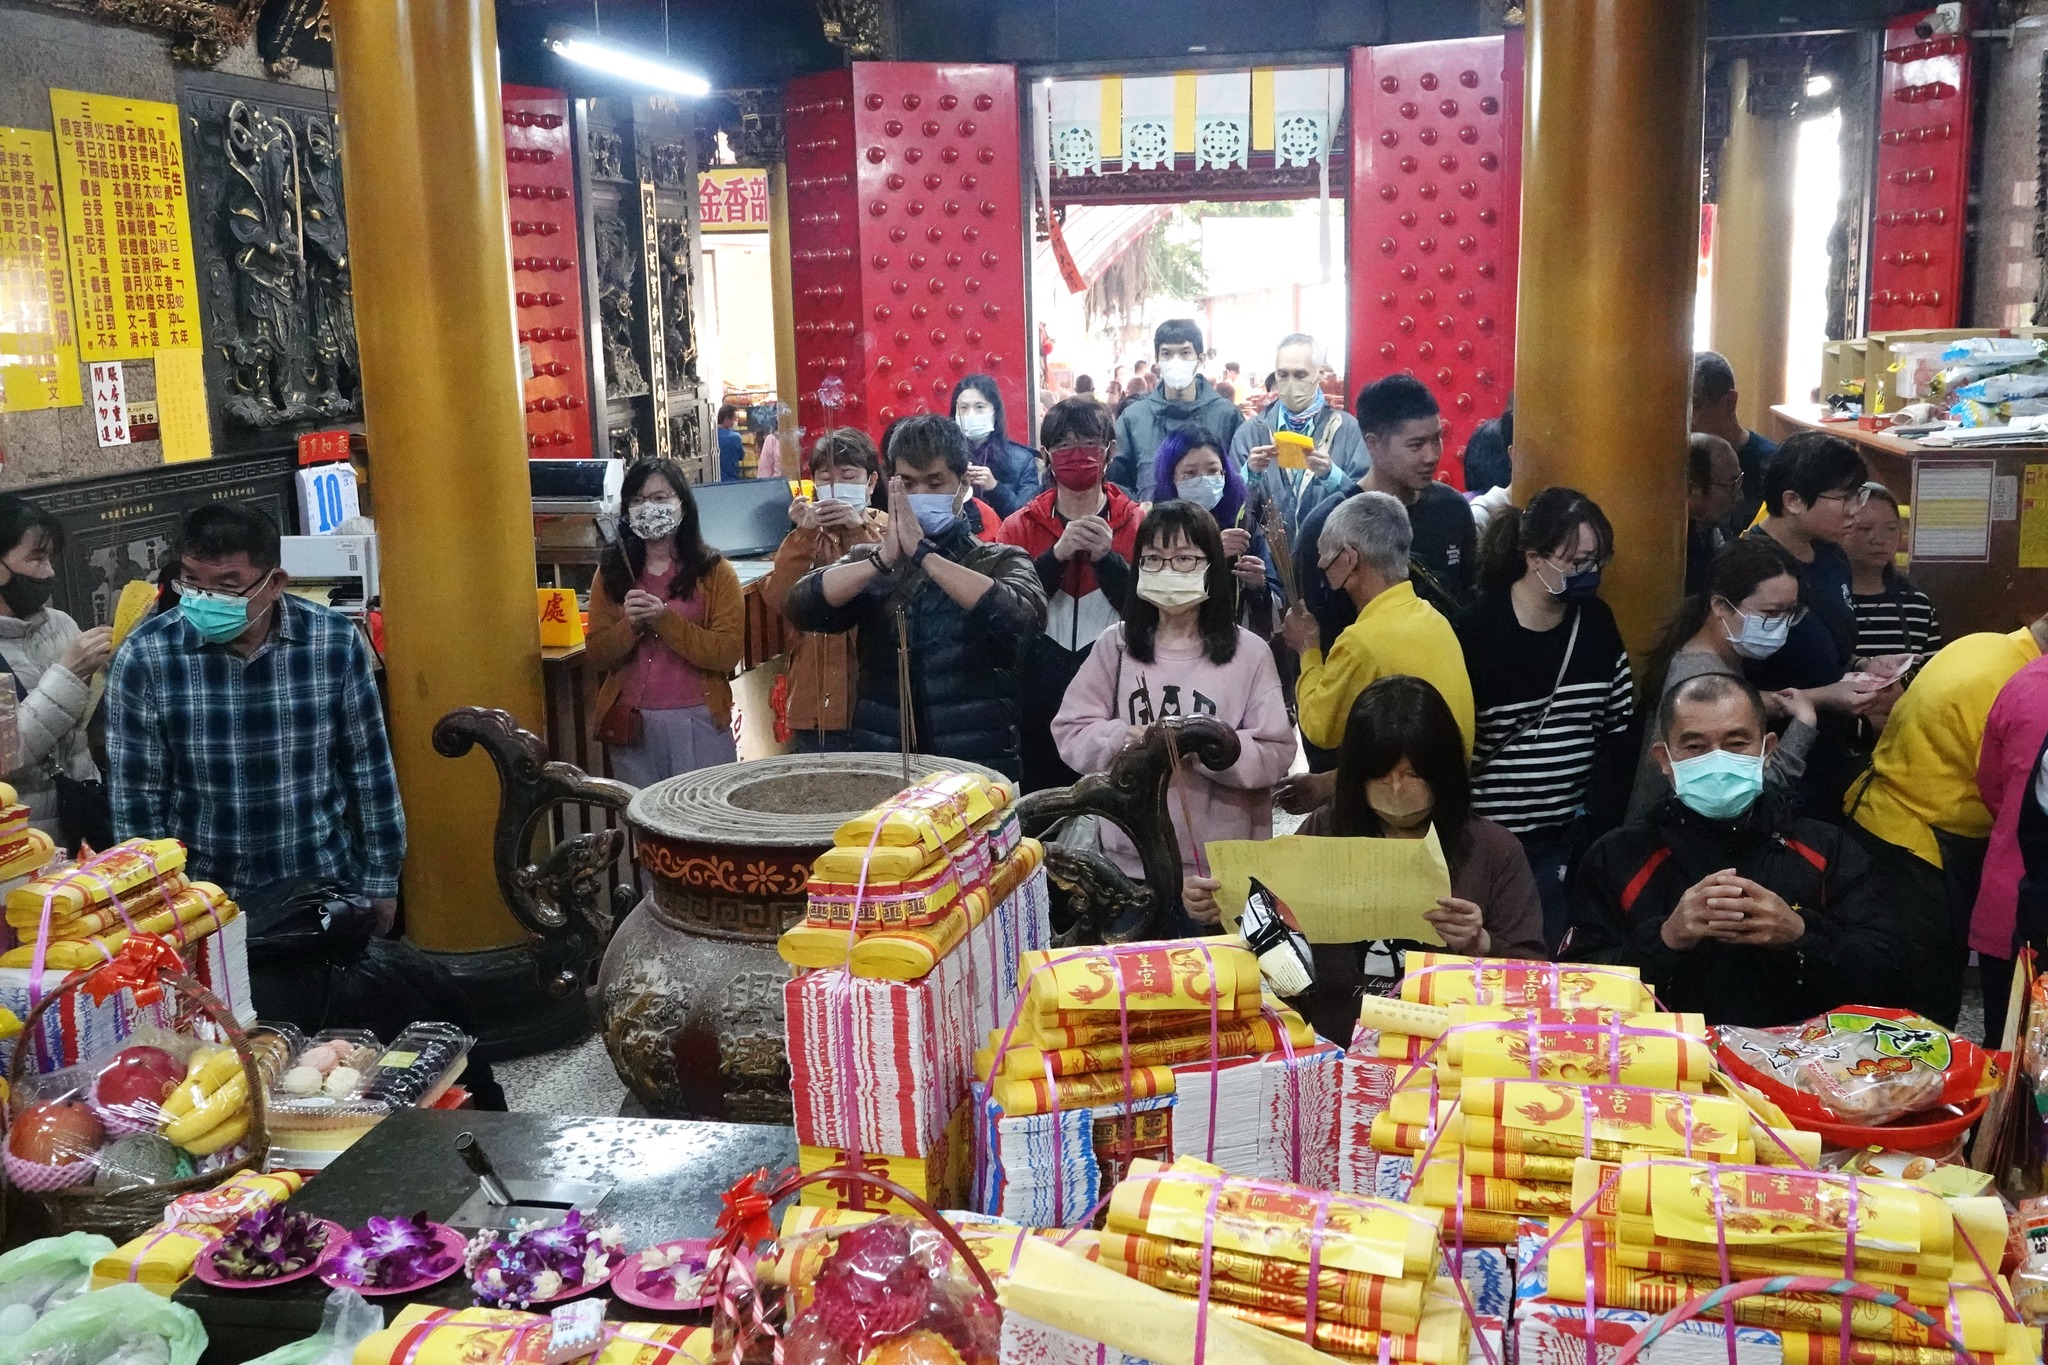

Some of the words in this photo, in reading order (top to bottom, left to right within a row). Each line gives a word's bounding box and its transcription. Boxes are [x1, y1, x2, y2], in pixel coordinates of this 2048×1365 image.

[169, 141, 182, 196] 公告
[699, 177, 768, 223] 金香部
[40, 180, 72, 347] 本宮宮規
[130, 412, 154, 425] 監視中
[313, 473, 344, 532] 10
[540, 592, 568, 624] 處
[1137, 953, 1157, 987] 皇宮
